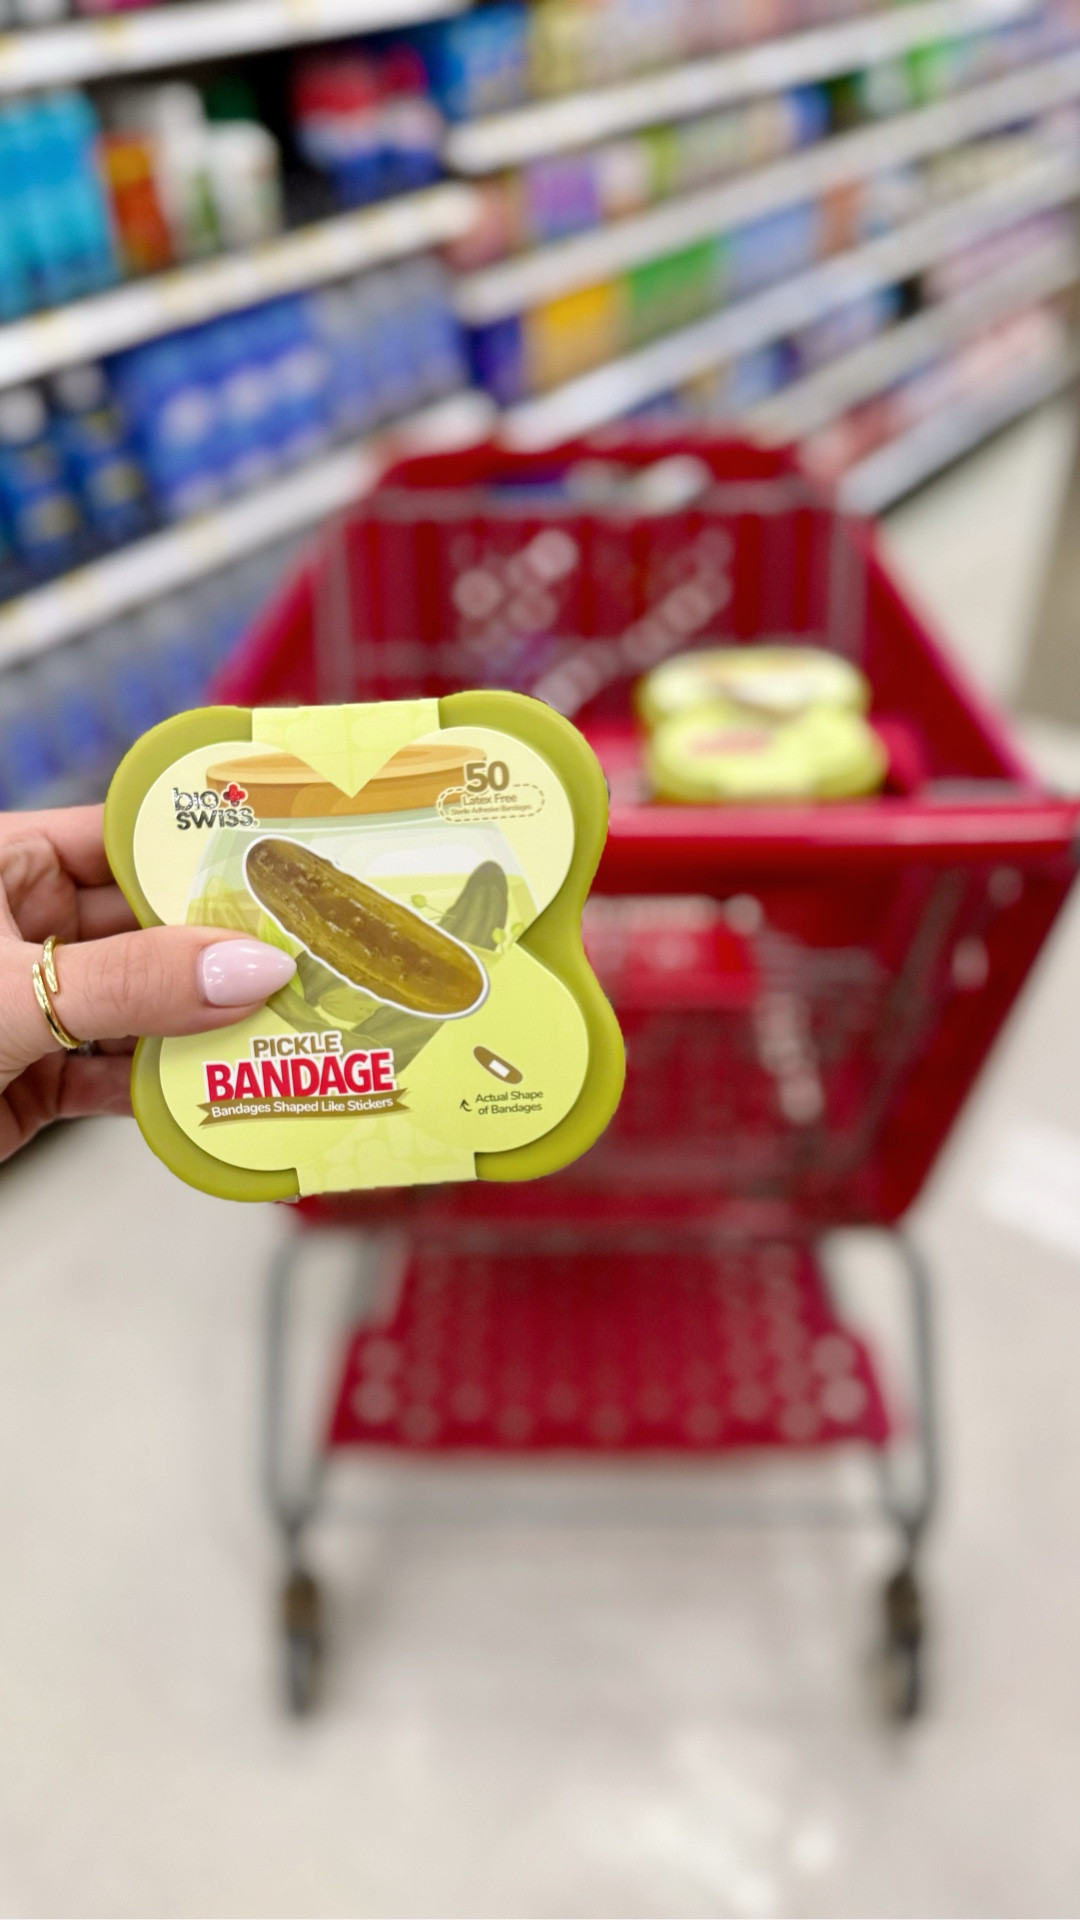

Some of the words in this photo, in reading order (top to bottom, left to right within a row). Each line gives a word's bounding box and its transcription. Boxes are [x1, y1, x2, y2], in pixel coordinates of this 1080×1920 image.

[466, 761, 510, 793] 50
[463, 795, 492, 806] Latex
[494, 793, 518, 804] Free
[253, 1034, 340, 1058] PICKLE
[206, 1051, 394, 1103] BANDAGE
[211, 1102, 271, 1118] Bandages
[274, 1101, 319, 1114] Shaped
[321, 1099, 346, 1112] Like
[347, 1097, 394, 1111] Stickers
[476, 1092, 508, 1103] Actual
[510, 1091, 544, 1101] Shape
[478, 1105, 488, 1115] of
[491, 1103, 543, 1114] Bandages
